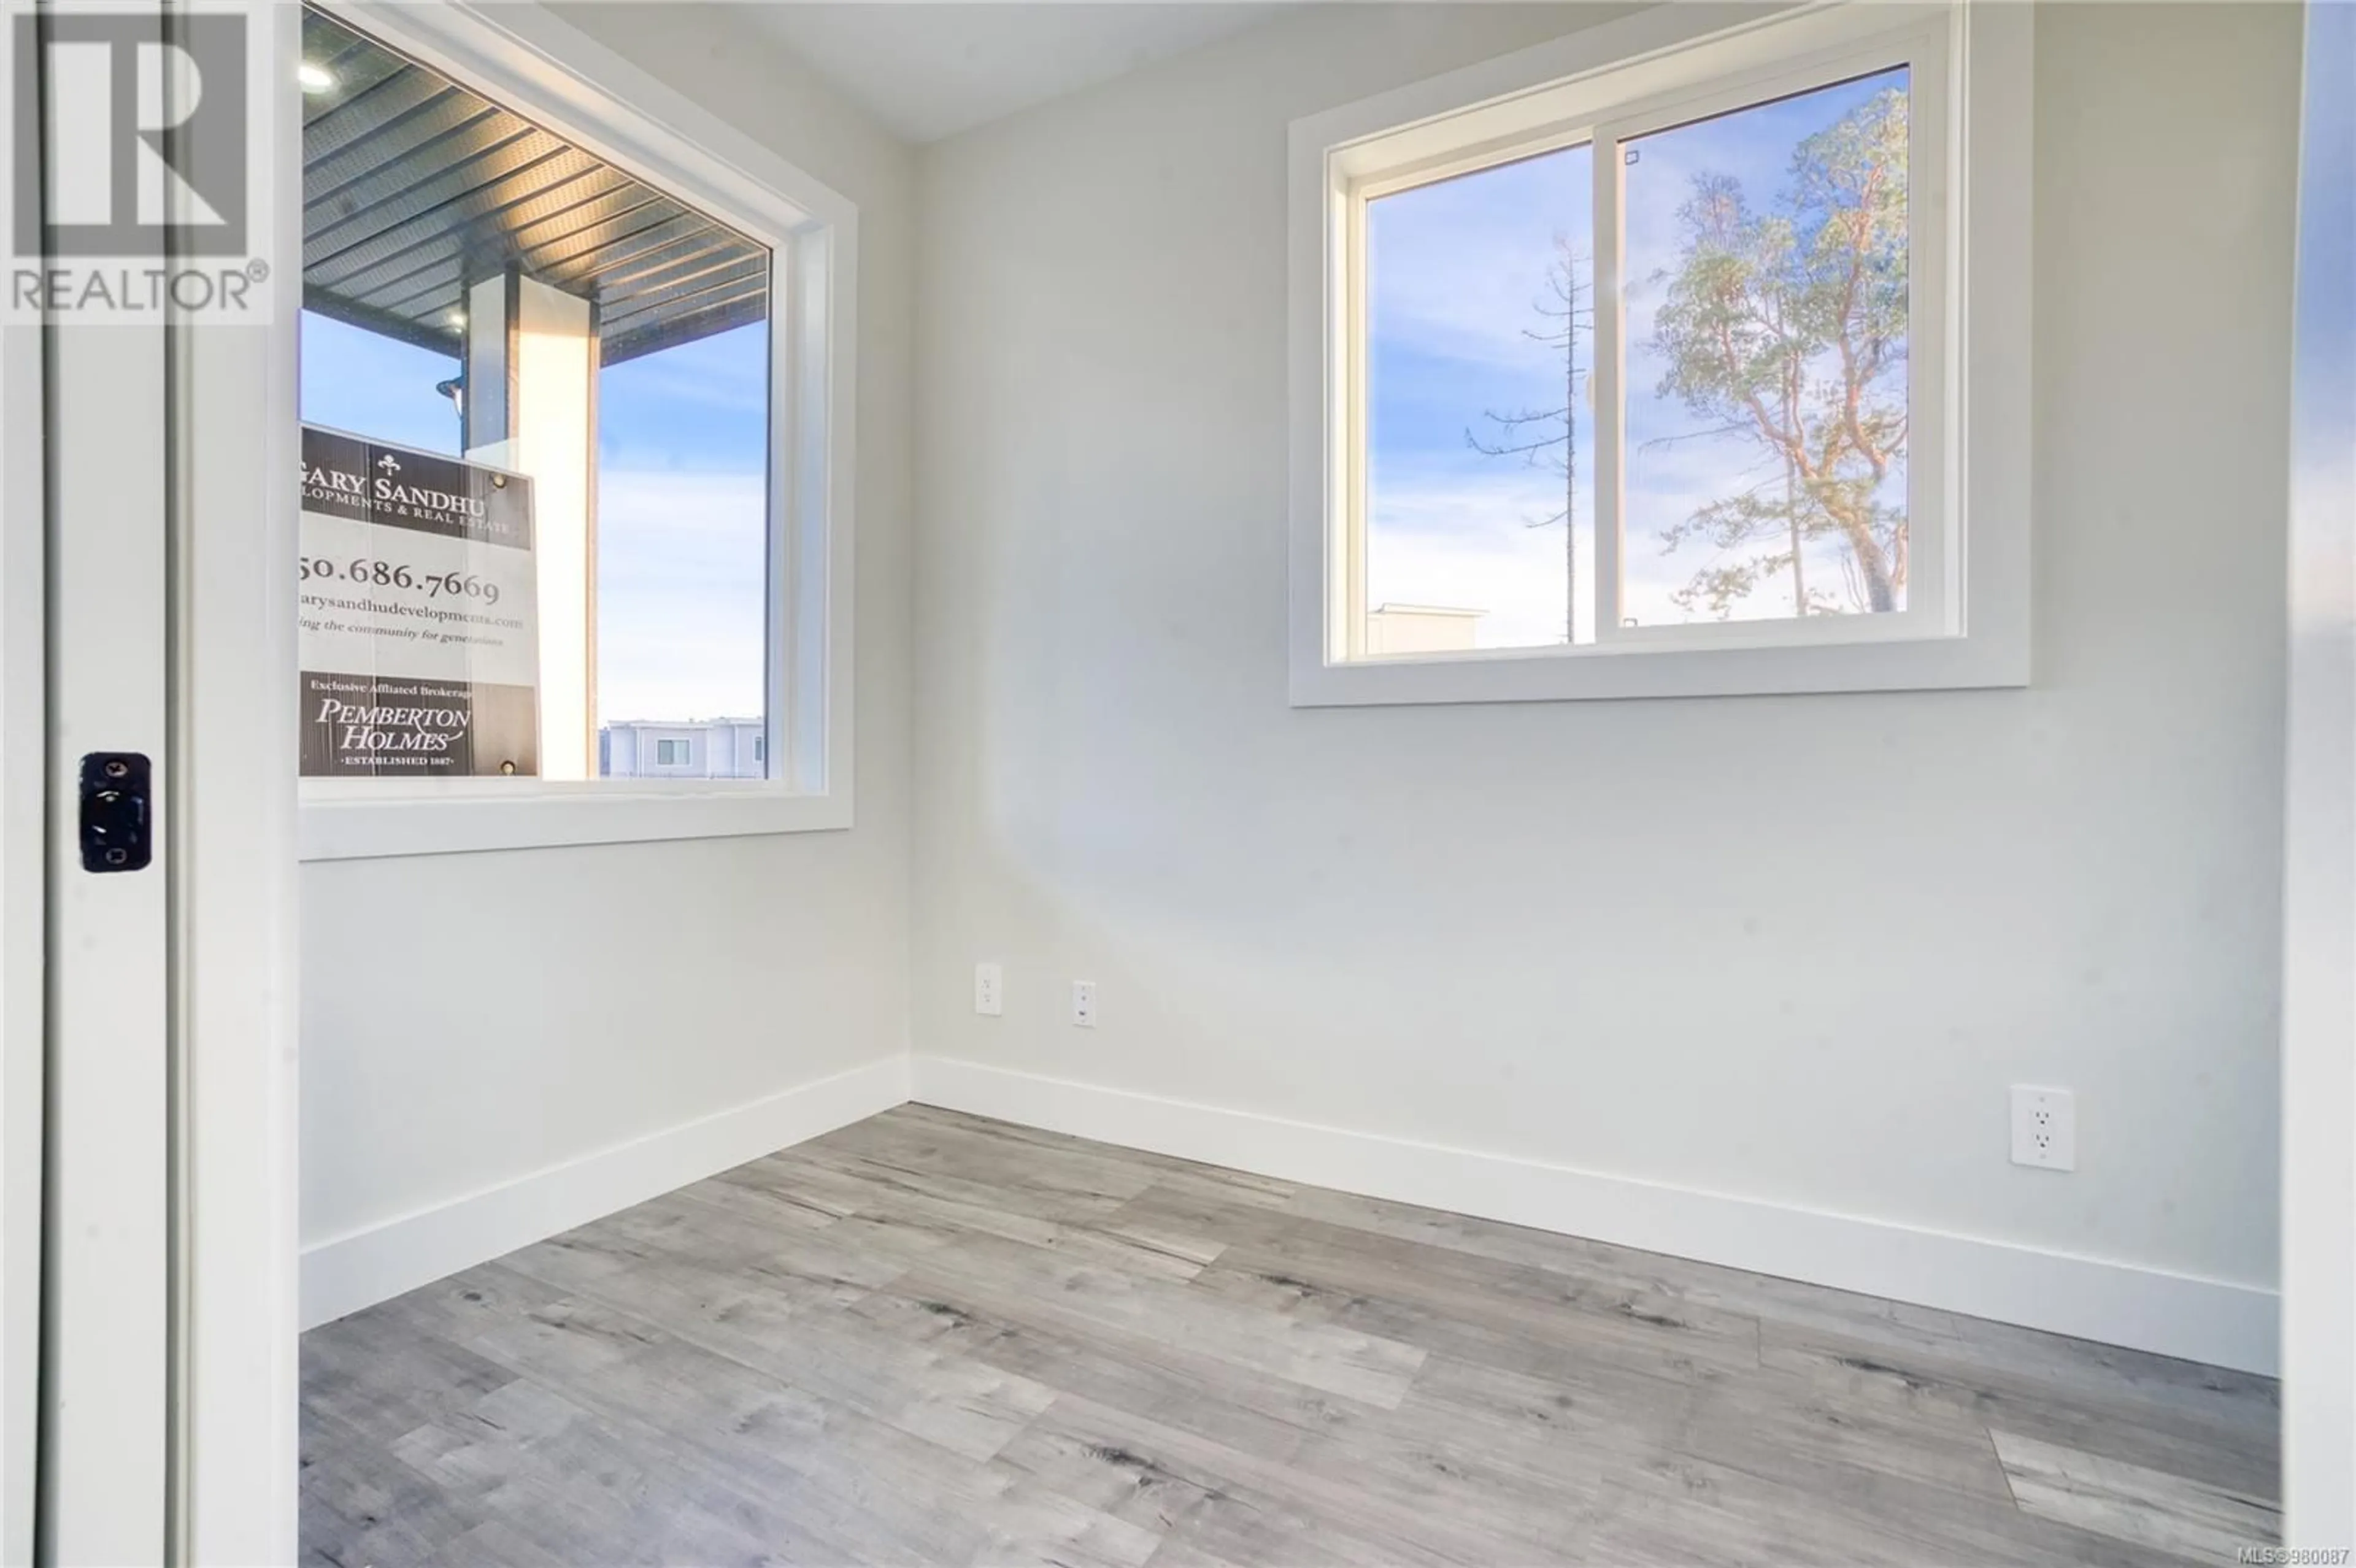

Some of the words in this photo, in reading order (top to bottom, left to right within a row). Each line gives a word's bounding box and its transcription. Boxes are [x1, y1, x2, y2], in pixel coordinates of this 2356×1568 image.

[375, 478, 485, 517] SANDHU
[398, 505, 407, 516] &
[414, 507, 453, 524] REAL
[459, 515, 509, 535] ESTATE
[324, 620, 345, 631] the
[347, 626, 417, 640] community
[422, 629, 439, 640] for
[310, 679, 368, 692] Exclusive
[315, 698, 471, 731] PEMBERTON
[341, 726, 457, 751] HOLMES
